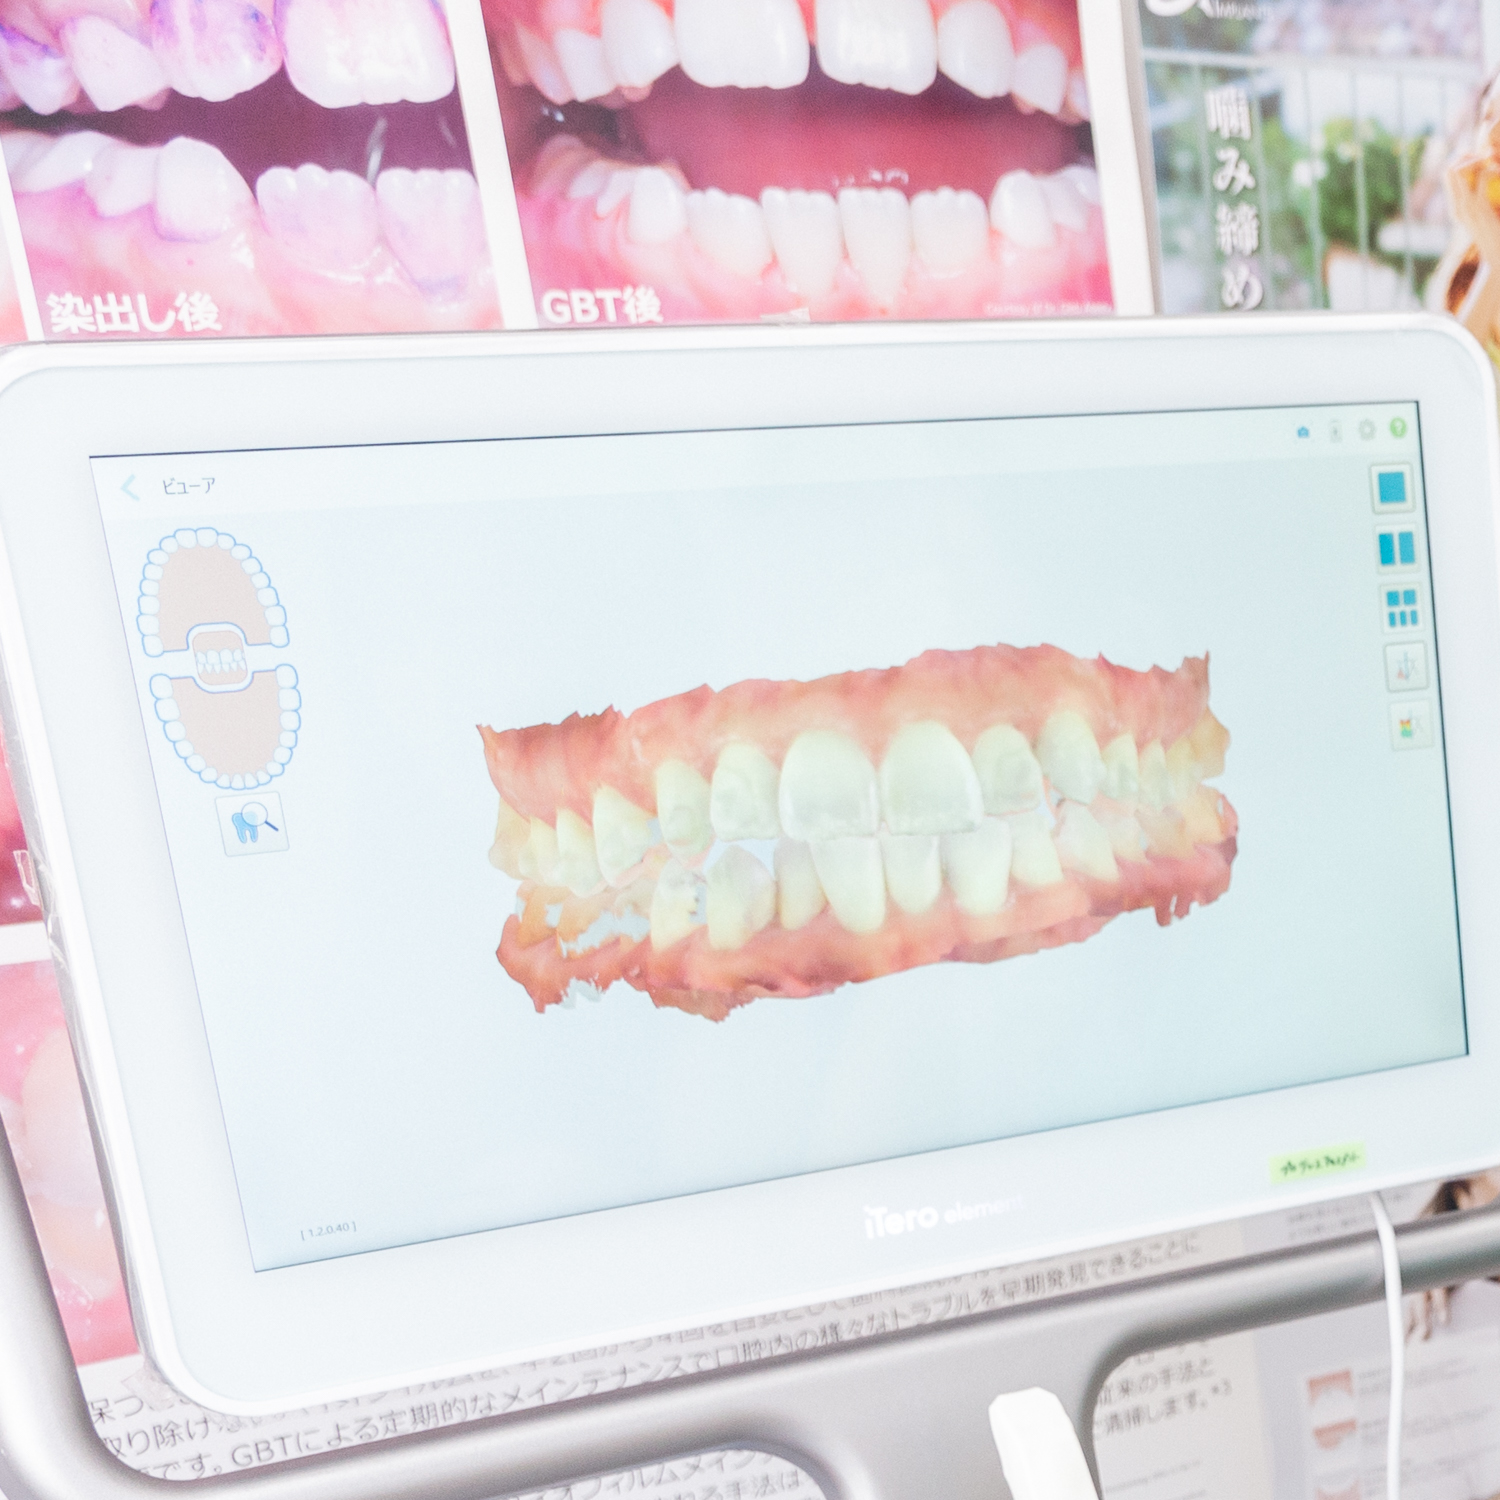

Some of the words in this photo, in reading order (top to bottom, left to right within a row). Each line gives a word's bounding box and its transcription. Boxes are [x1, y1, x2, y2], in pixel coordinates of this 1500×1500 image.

[46, 291, 223, 334] 染出し後
[542, 285, 664, 324] GBT後
[162, 477, 215, 496] ビューア
[863, 1204, 939, 1239] iTero
[944, 1196, 1025, 1225] element
